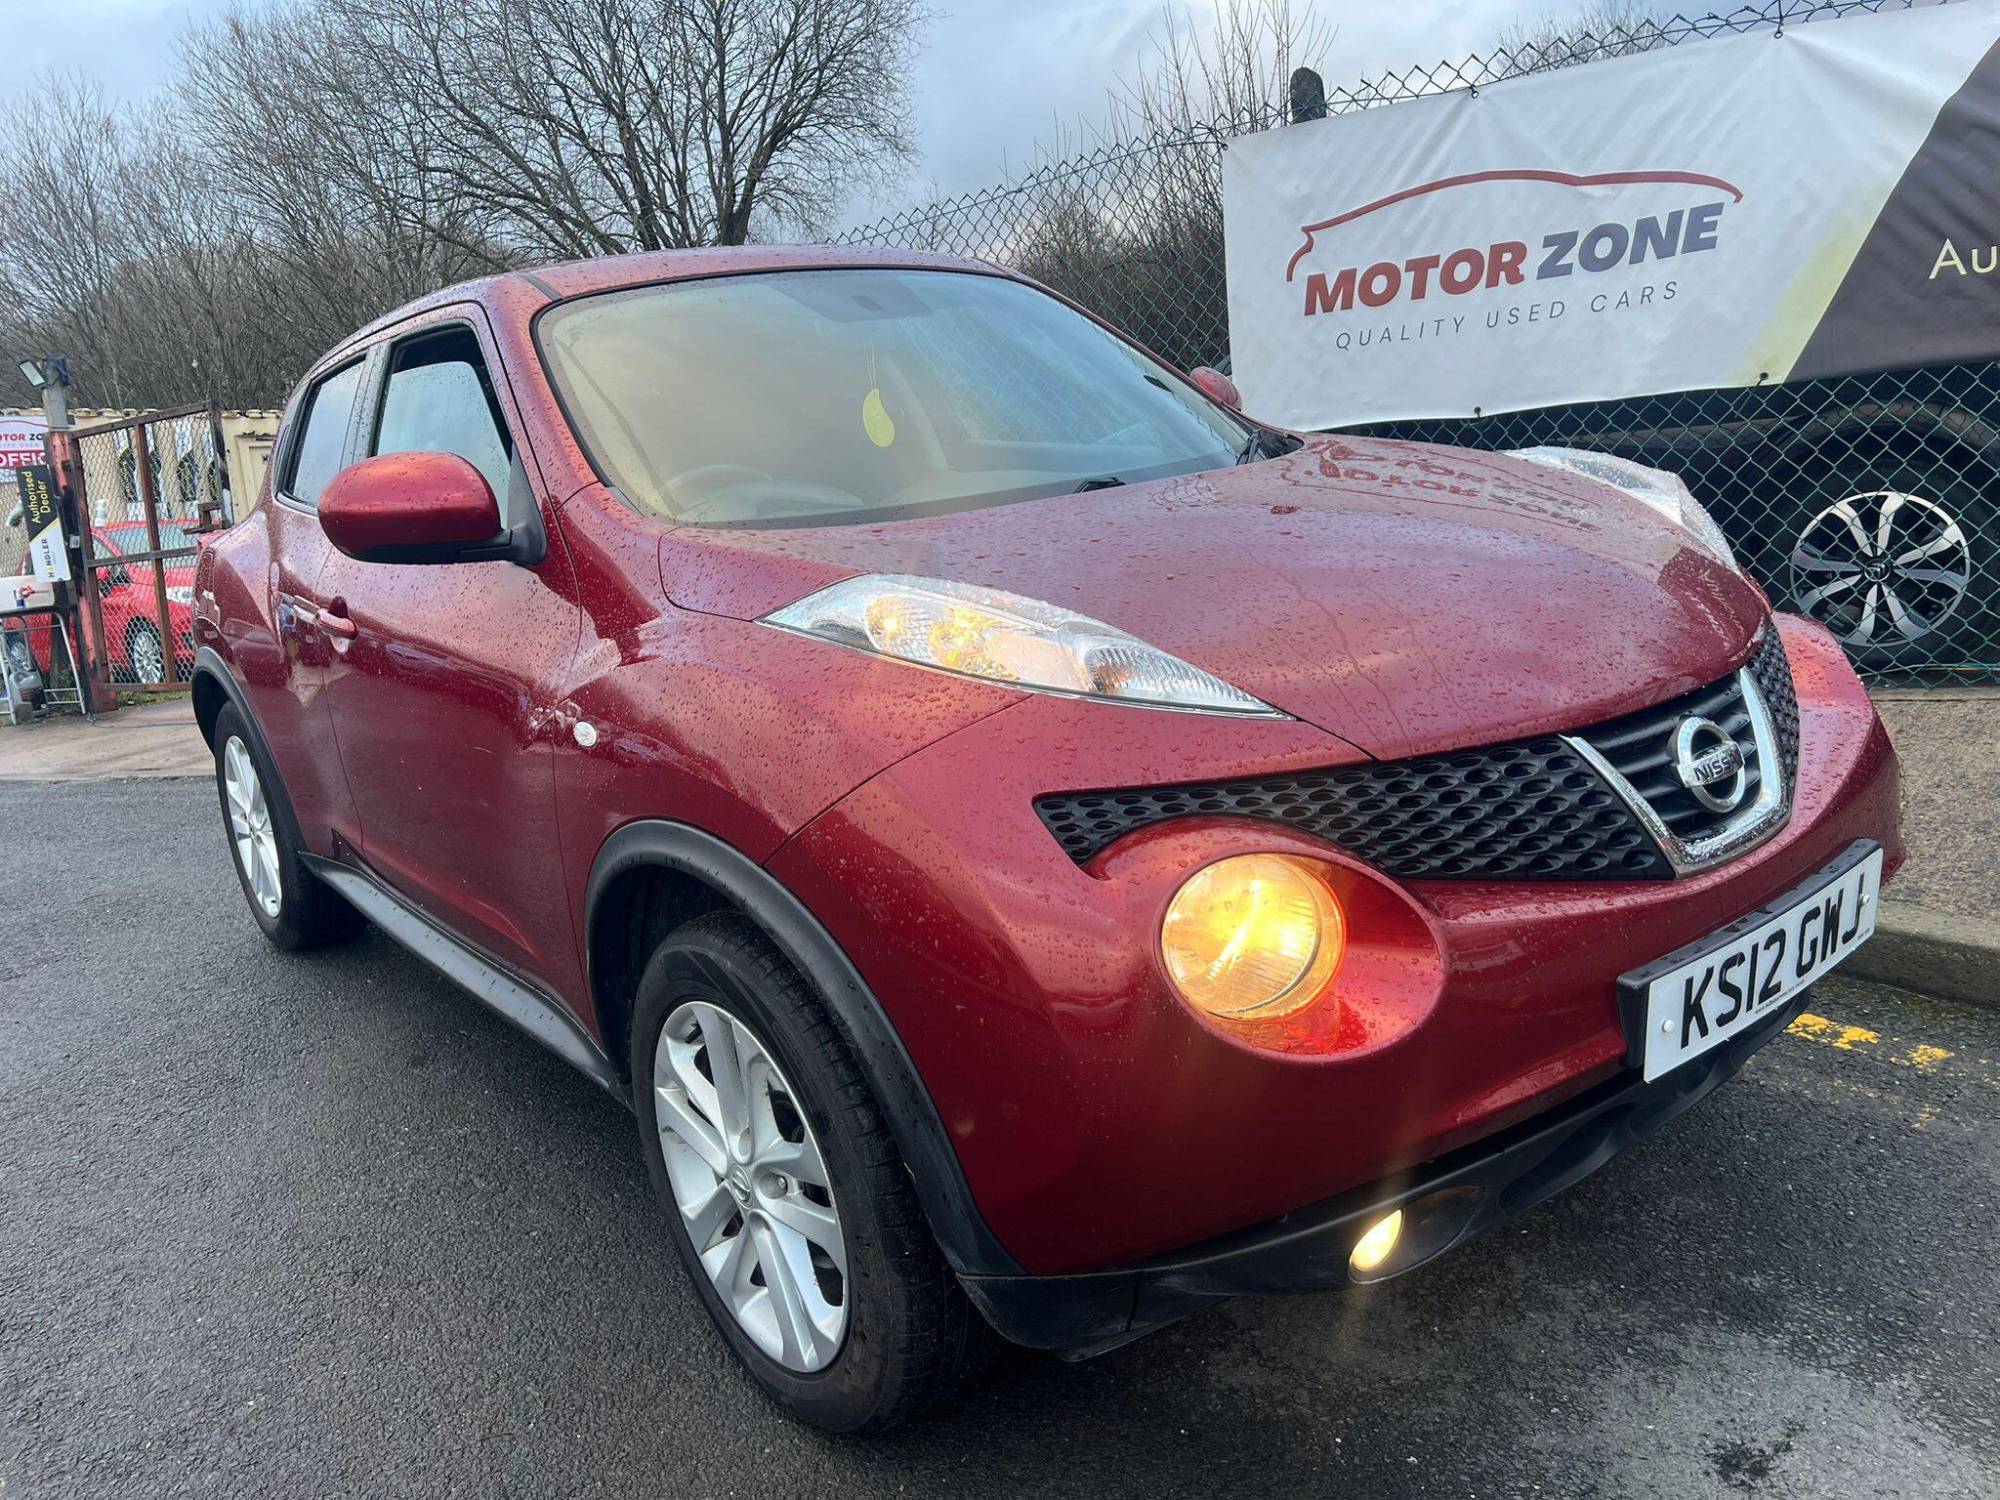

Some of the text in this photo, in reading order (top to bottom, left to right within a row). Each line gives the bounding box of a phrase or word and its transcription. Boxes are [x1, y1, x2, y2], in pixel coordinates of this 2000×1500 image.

[1304, 202, 1725, 316] MOTOR ZONE
[1928, 237, 1997, 279] Au
[1336, 281, 1678, 351] QUALITY USED CARS
[21, 471, 41, 524] Authorised
[36, 480, 50, 514] Dealer
[1680, 872, 1865, 1049] KS12 GWJ
